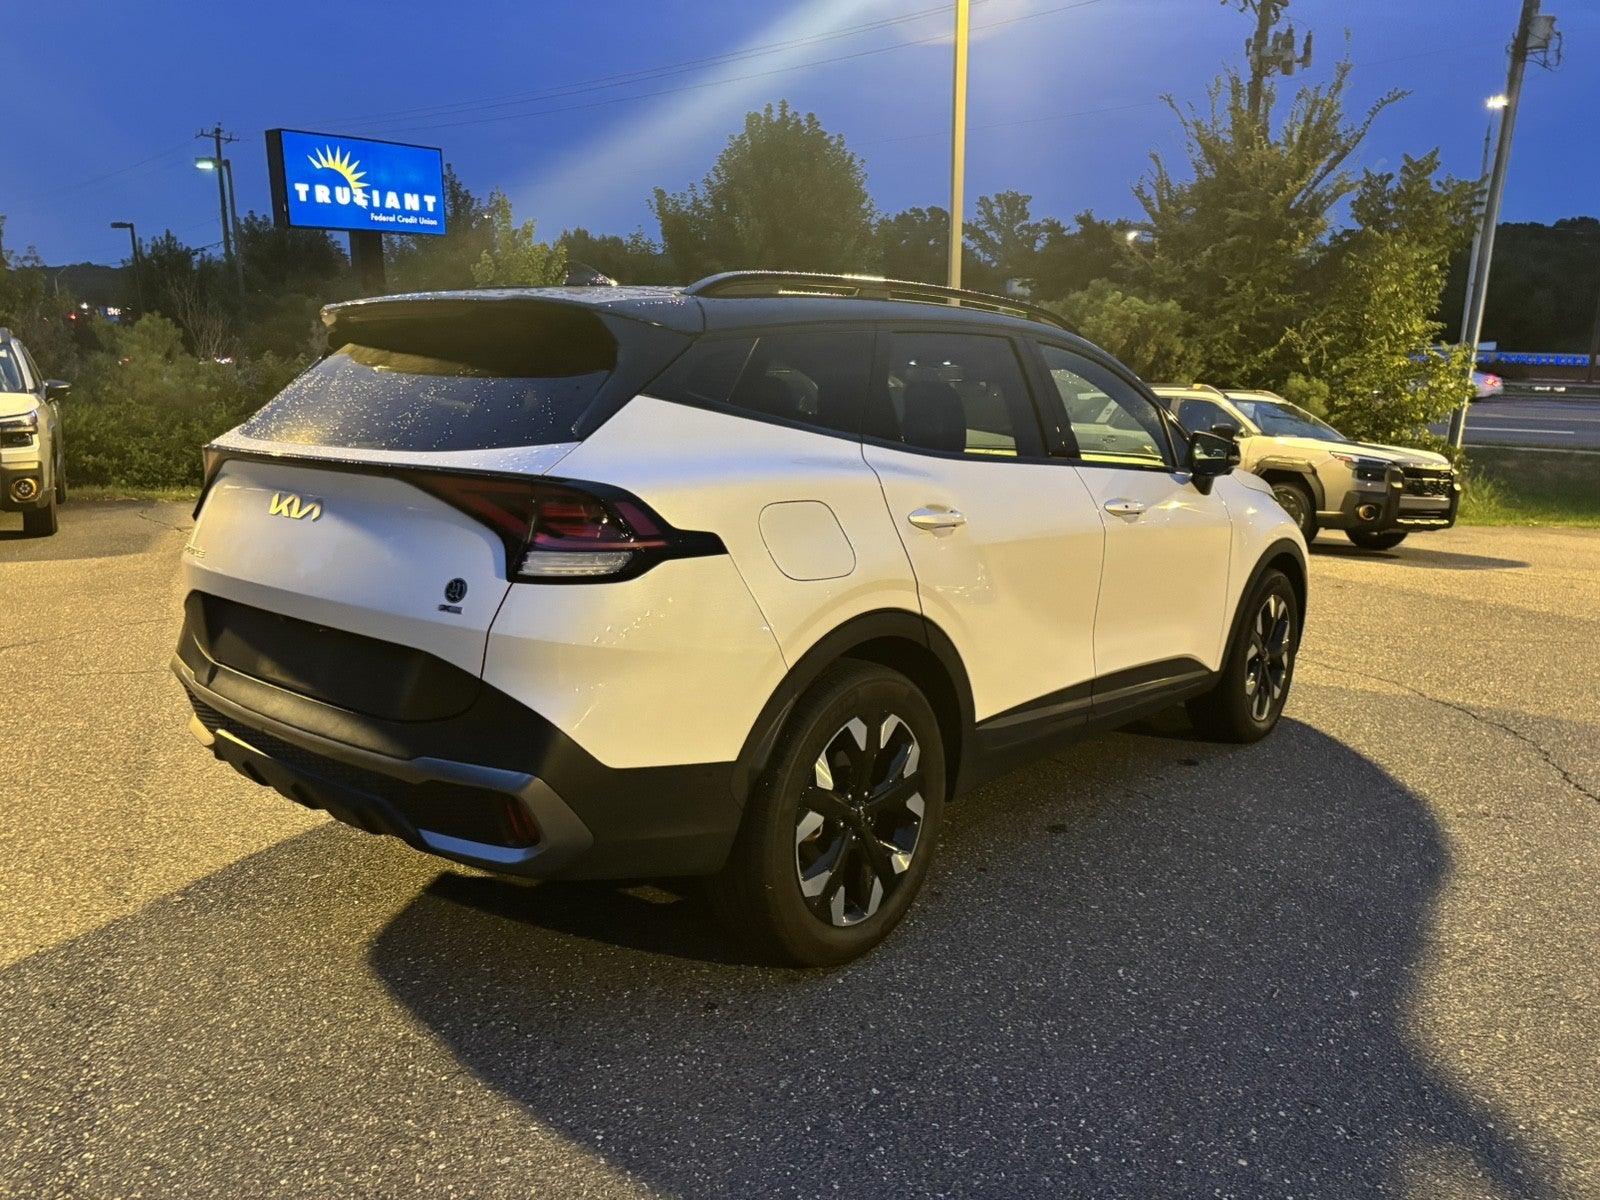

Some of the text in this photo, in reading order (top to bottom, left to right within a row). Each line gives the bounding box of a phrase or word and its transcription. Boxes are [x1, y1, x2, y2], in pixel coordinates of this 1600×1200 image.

[370, 212, 438, 226] Federal Credit Union
[269, 492, 322, 522] KIA
